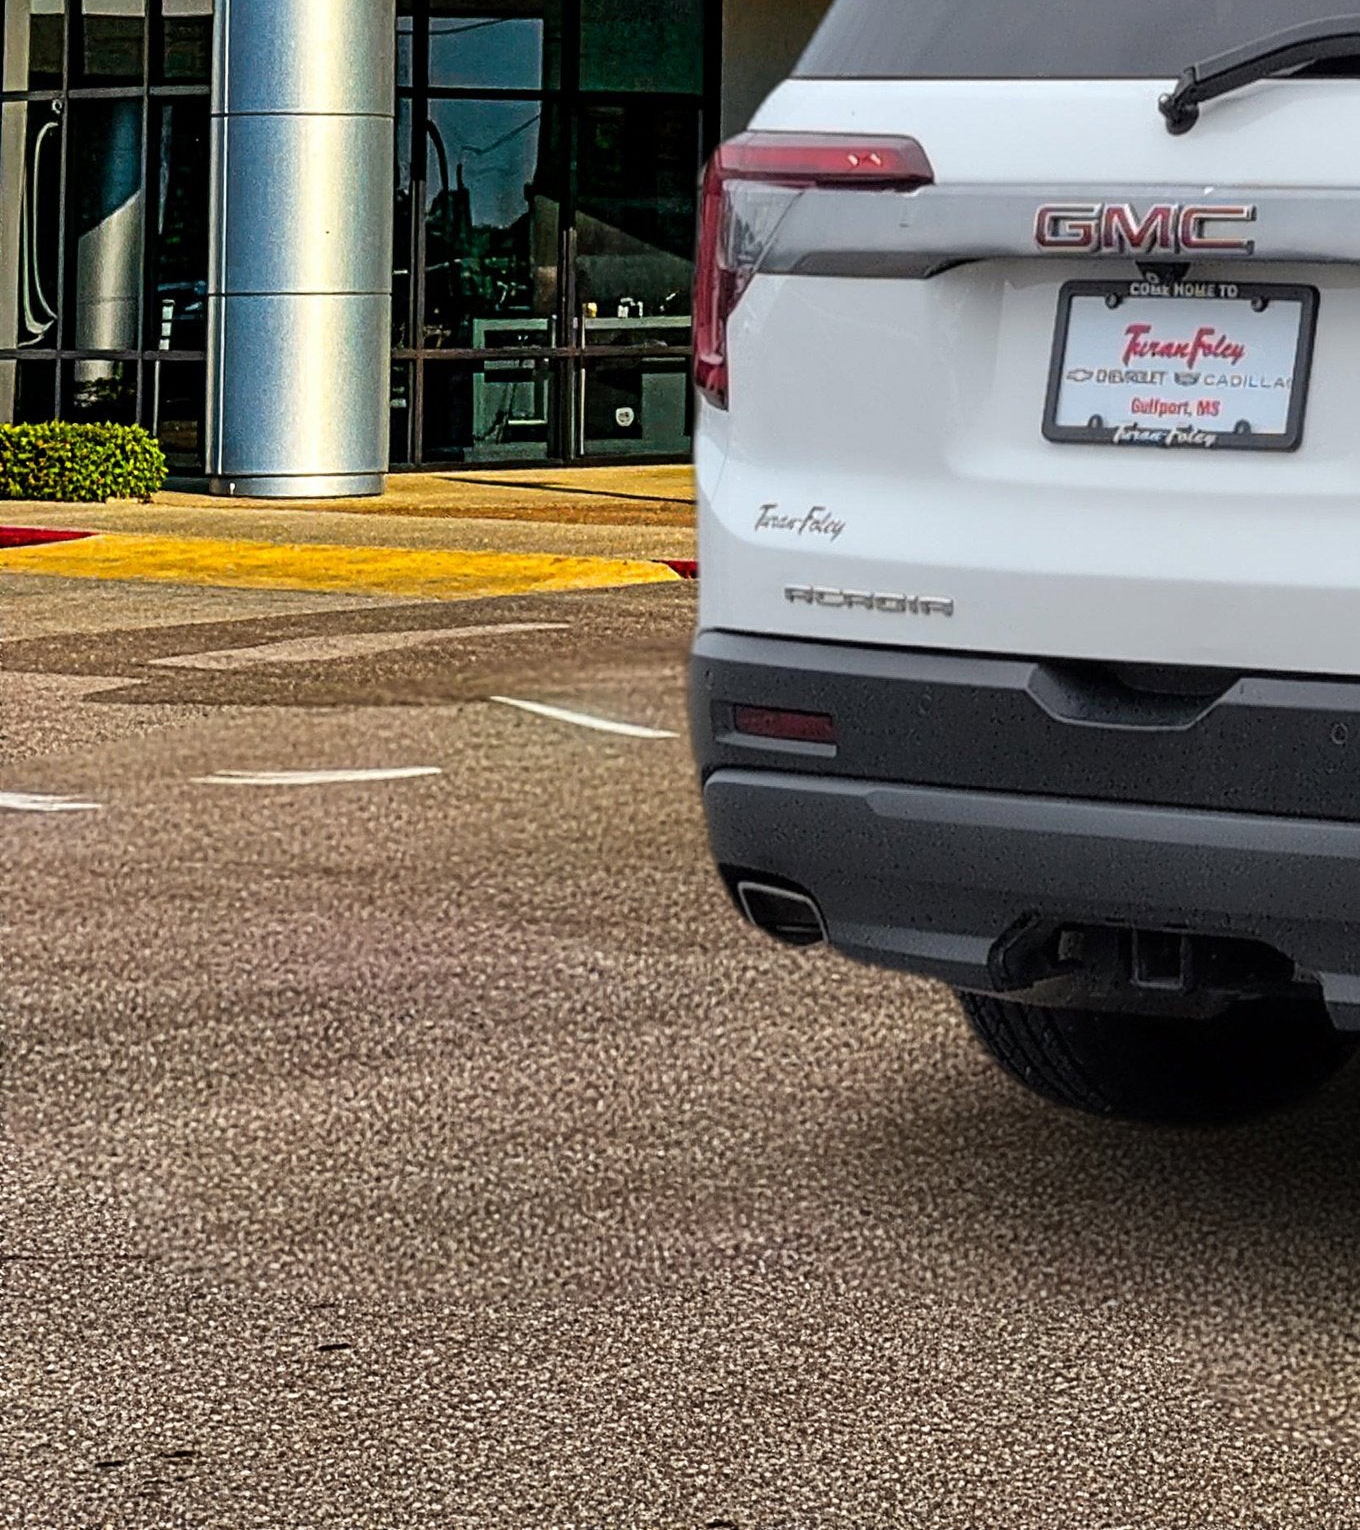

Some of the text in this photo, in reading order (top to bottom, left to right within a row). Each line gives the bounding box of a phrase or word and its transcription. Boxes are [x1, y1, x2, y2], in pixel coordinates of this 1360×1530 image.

[1034, 203, 1257, 254] GMC
[1173, 283, 1216, 297] HOME
[1218, 284, 1239, 298] TO
[1196, 400, 1221, 417] MS
[783, 583, 955, 617] ACADIA
